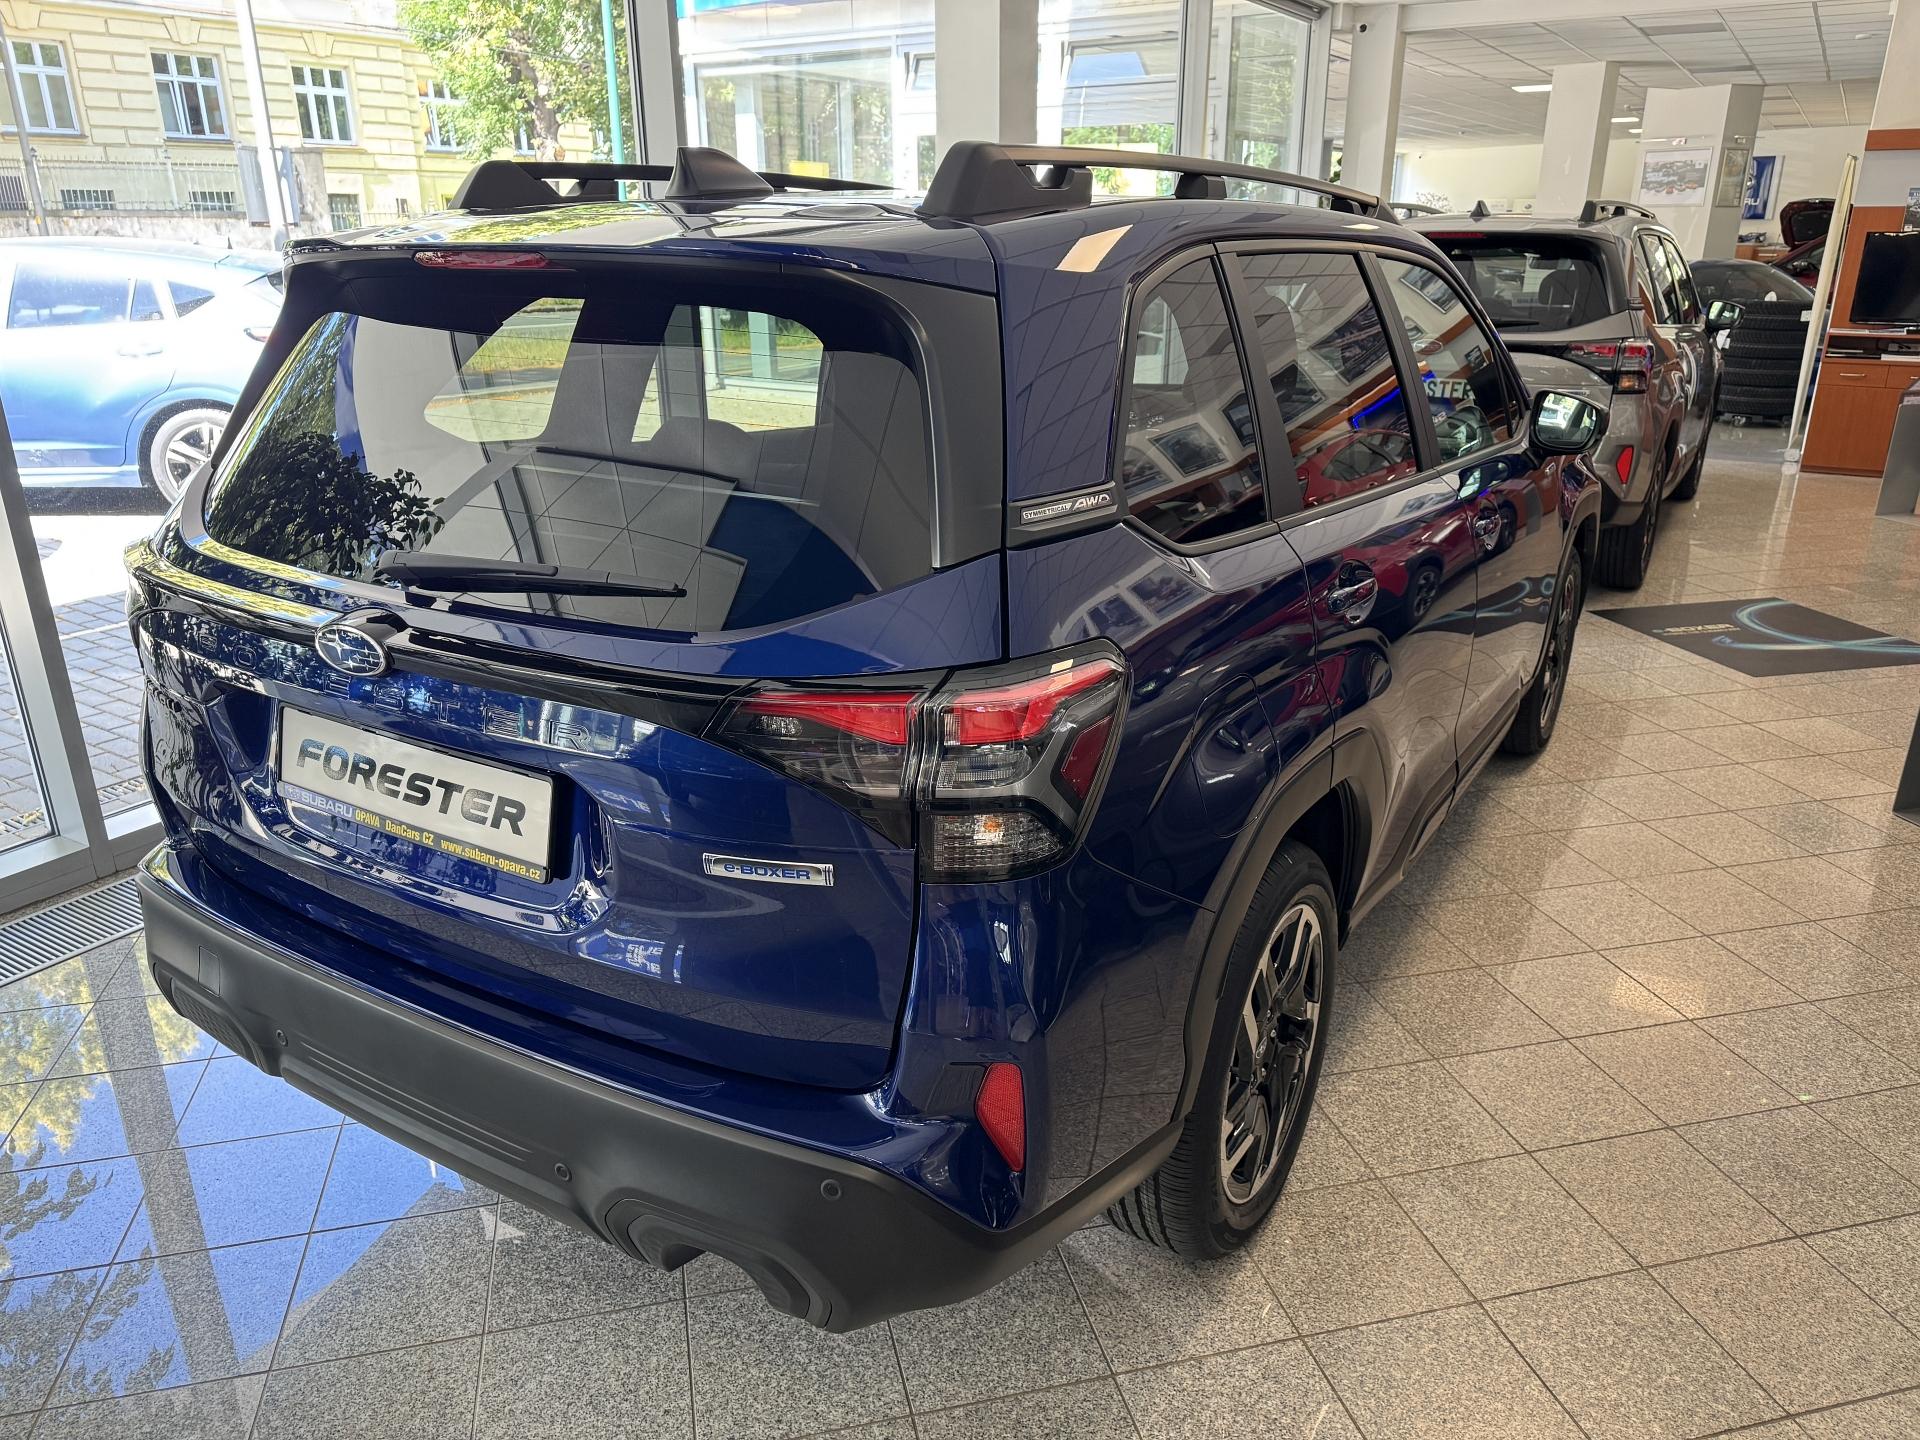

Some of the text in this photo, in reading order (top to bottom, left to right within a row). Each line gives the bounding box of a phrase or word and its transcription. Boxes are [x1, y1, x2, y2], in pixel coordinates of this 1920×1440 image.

[1023, 493, 1110, 519] SYMMETRICAL AWD
[296, 738, 526, 837] FORESTER
[301, 791, 540, 880] SUBARU OPAVA DanCars CZ www.subaru-opava.cz
[723, 863, 811, 880] e-BOXER
